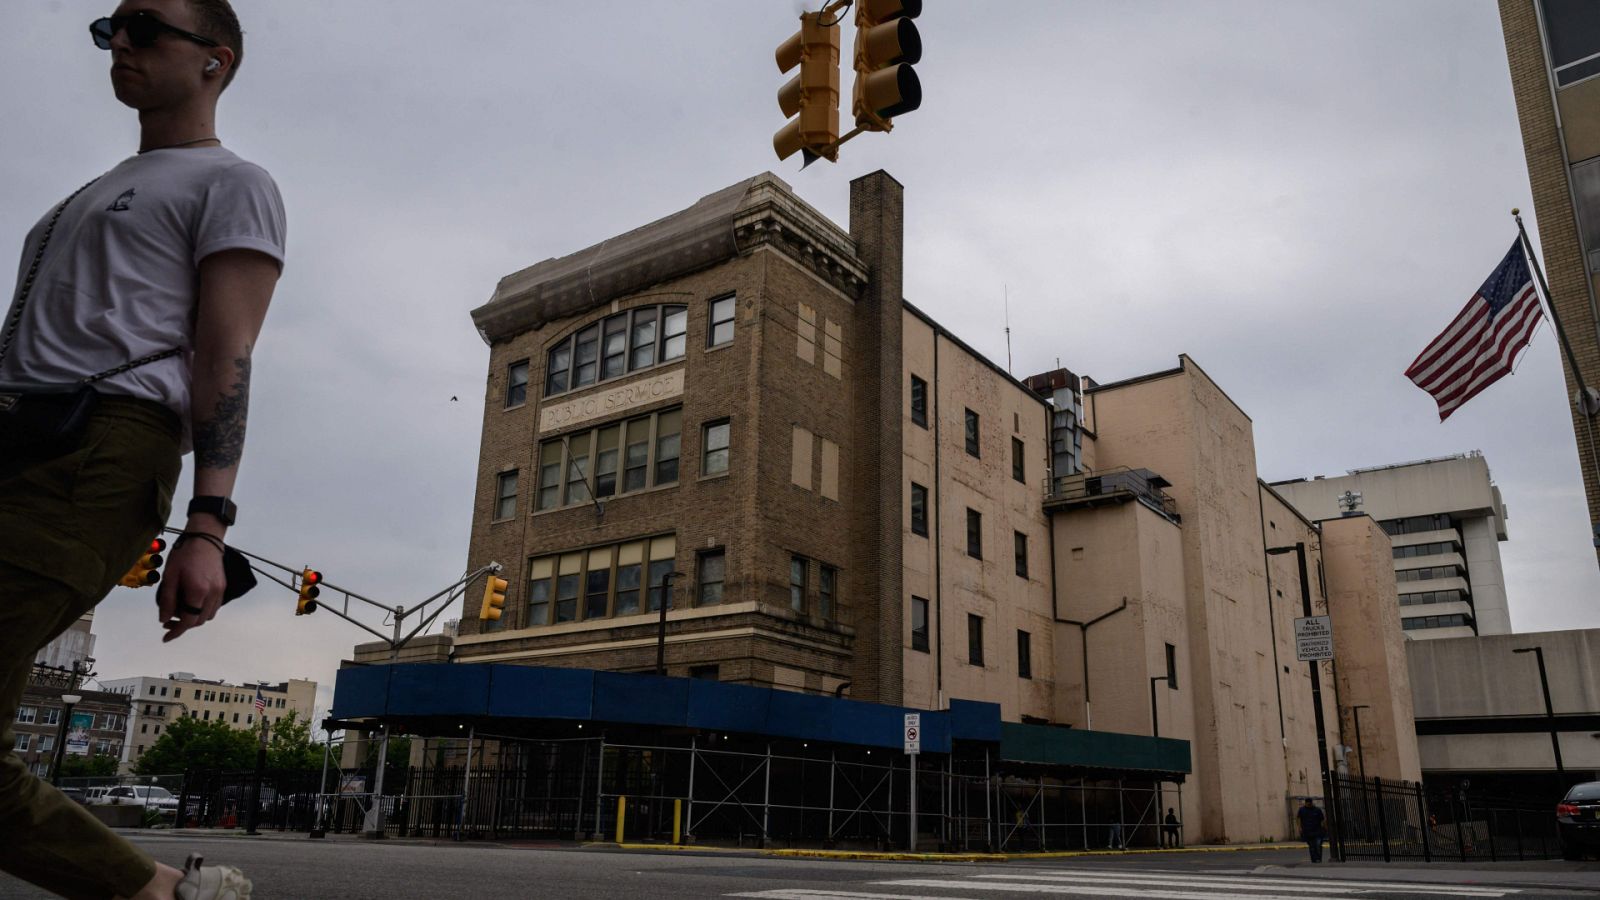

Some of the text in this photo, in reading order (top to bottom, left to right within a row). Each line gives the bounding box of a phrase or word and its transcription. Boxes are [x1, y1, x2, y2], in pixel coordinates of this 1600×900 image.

[546, 376, 674, 426] PUBLIC SERVICE
[1305, 618, 1320, 626] ALL
